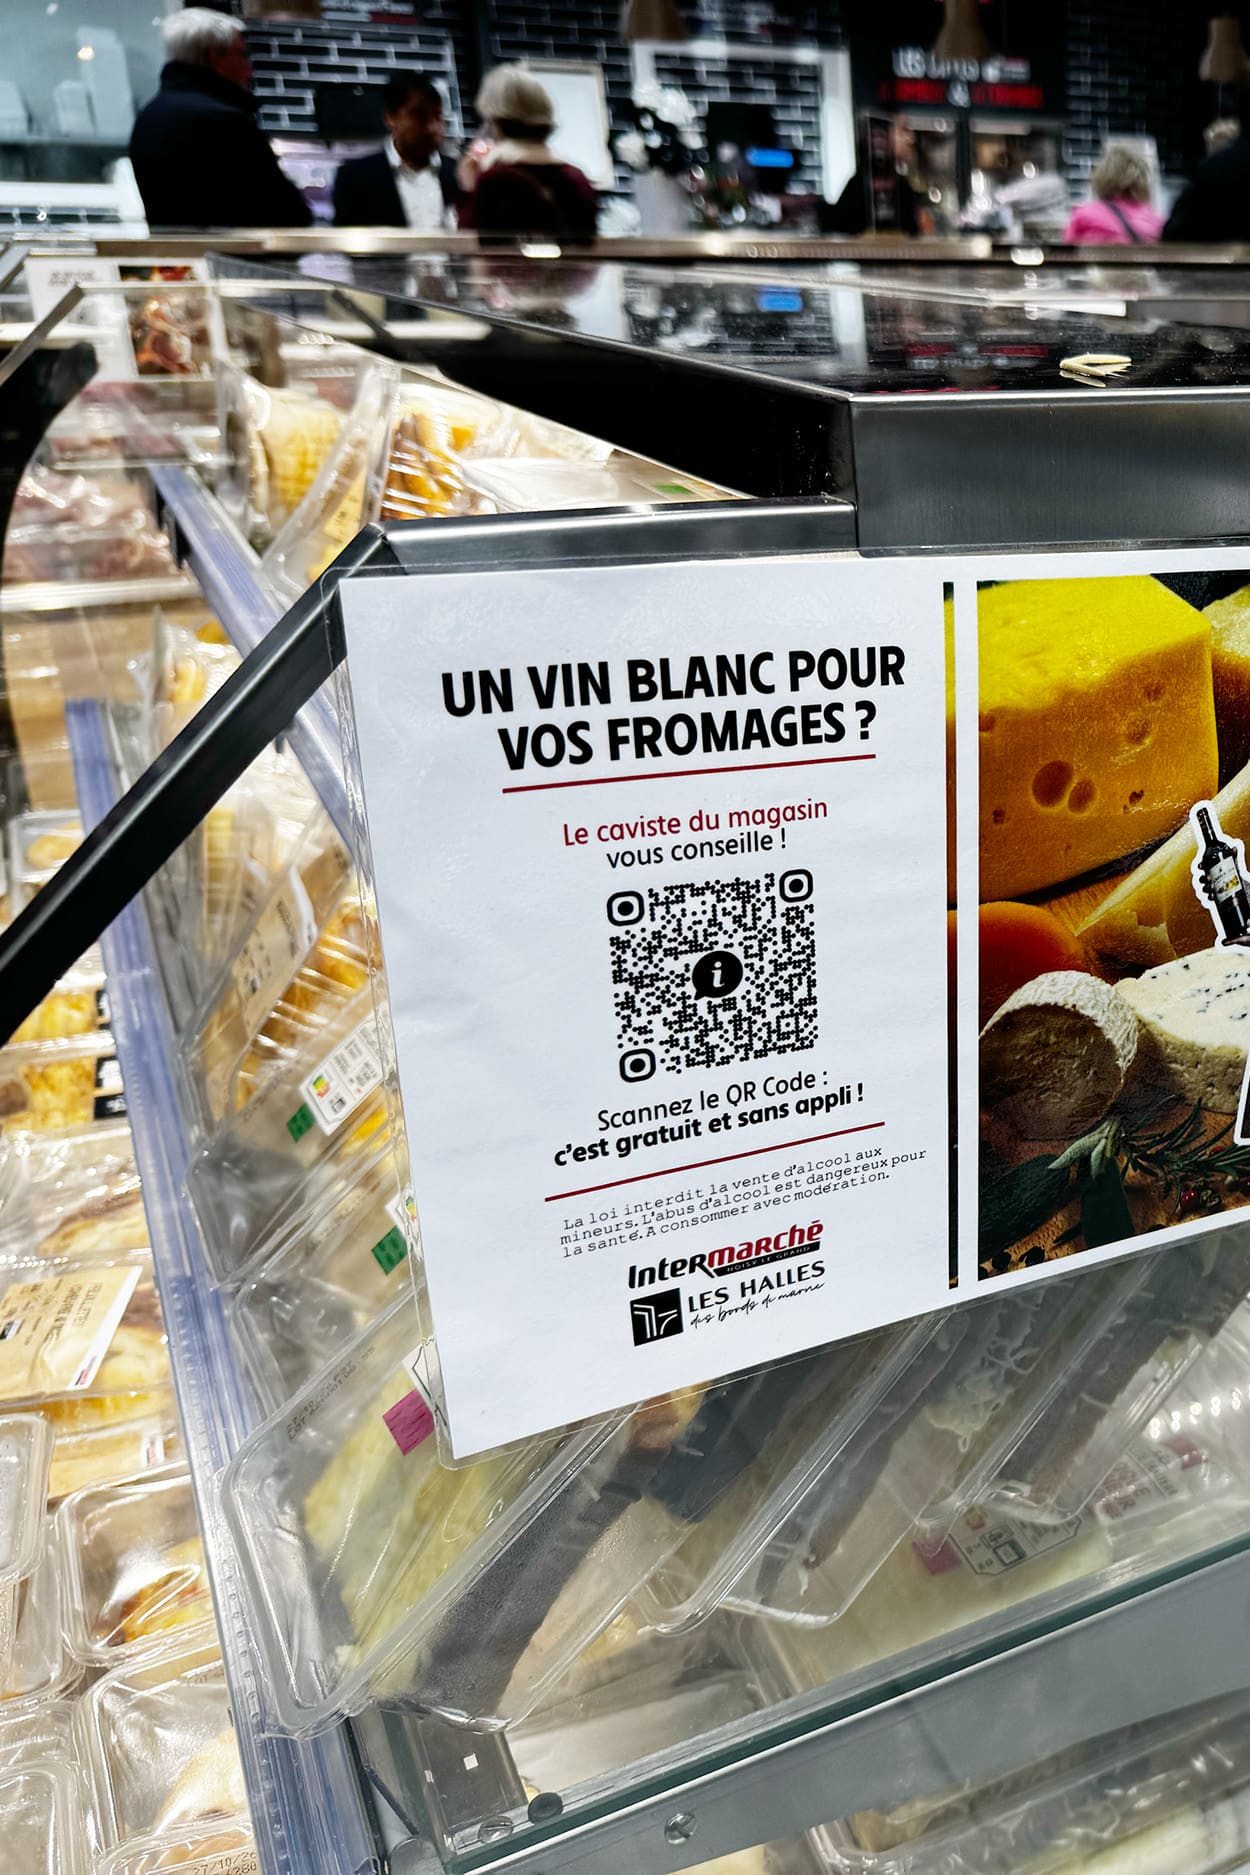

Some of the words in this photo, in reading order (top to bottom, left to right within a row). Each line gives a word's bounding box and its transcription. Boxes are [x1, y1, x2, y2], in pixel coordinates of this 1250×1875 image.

[441, 668, 513, 718] UN
[527, 661, 611, 710] VIN
[627, 652, 776, 702] BLANC
[789, 645, 906, 692] POUR
[498, 721, 593, 771] VOS
[607, 702, 846, 761] FROMAGES
[563, 824, 588, 846] Le
[597, 815, 681, 842] caviste
[689, 809, 720, 832] du
[728, 798, 828, 830] magasin
[606, 846, 664, 869] vous
[671, 831, 773, 861] conseille
[554, 1138, 609, 1166] c'est
[616, 1118, 702, 1158] gratuit
[708, 1113, 732, 1133] et
[738, 1103, 789, 1127] sans
[795, 1085, 851, 1116] appli
[598, 1098, 693, 1131] Scannez
[700, 1090, 719, 1110] le
[726, 1081, 756, 1107] QR
[763, 1071, 816, 1096] Code
[560, 1219, 639, 1245] mineurs.
[642, 1205, 695, 1225] L'abus
[699, 1185, 770, 1211] d'alcool
[774, 1179, 802, 1192] est
[806, 1158, 888, 1185] dangereux
[891, 1149, 927, 1168] pour
[563, 1218, 584, 1230] La
[589, 1208, 618, 1224] loi
[624, 1189, 704, 1216] interdit
[709, 1184, 728, 1195] la
[732, 1171, 780, 1189] vente
[784, 1153, 851, 1177] d'alcool
[855, 1147, 883, 1161] aux
[563, 1246, 583, 1258] la
[646, 1226, 657, 1237] A
[660, 1206, 750, 1234] consommer
[753, 1193, 791, 1211] avec
[794, 1171, 890, 1200] modération.
[688, 1287, 729, 1313] LES
[740, 1260, 825, 1298] HALLES
[690, 1313, 715, 1329] des
[713, 1301, 758, 1322] bords
[761, 1294, 778, 1308] de
[778, 1282, 825, 1300] marne
